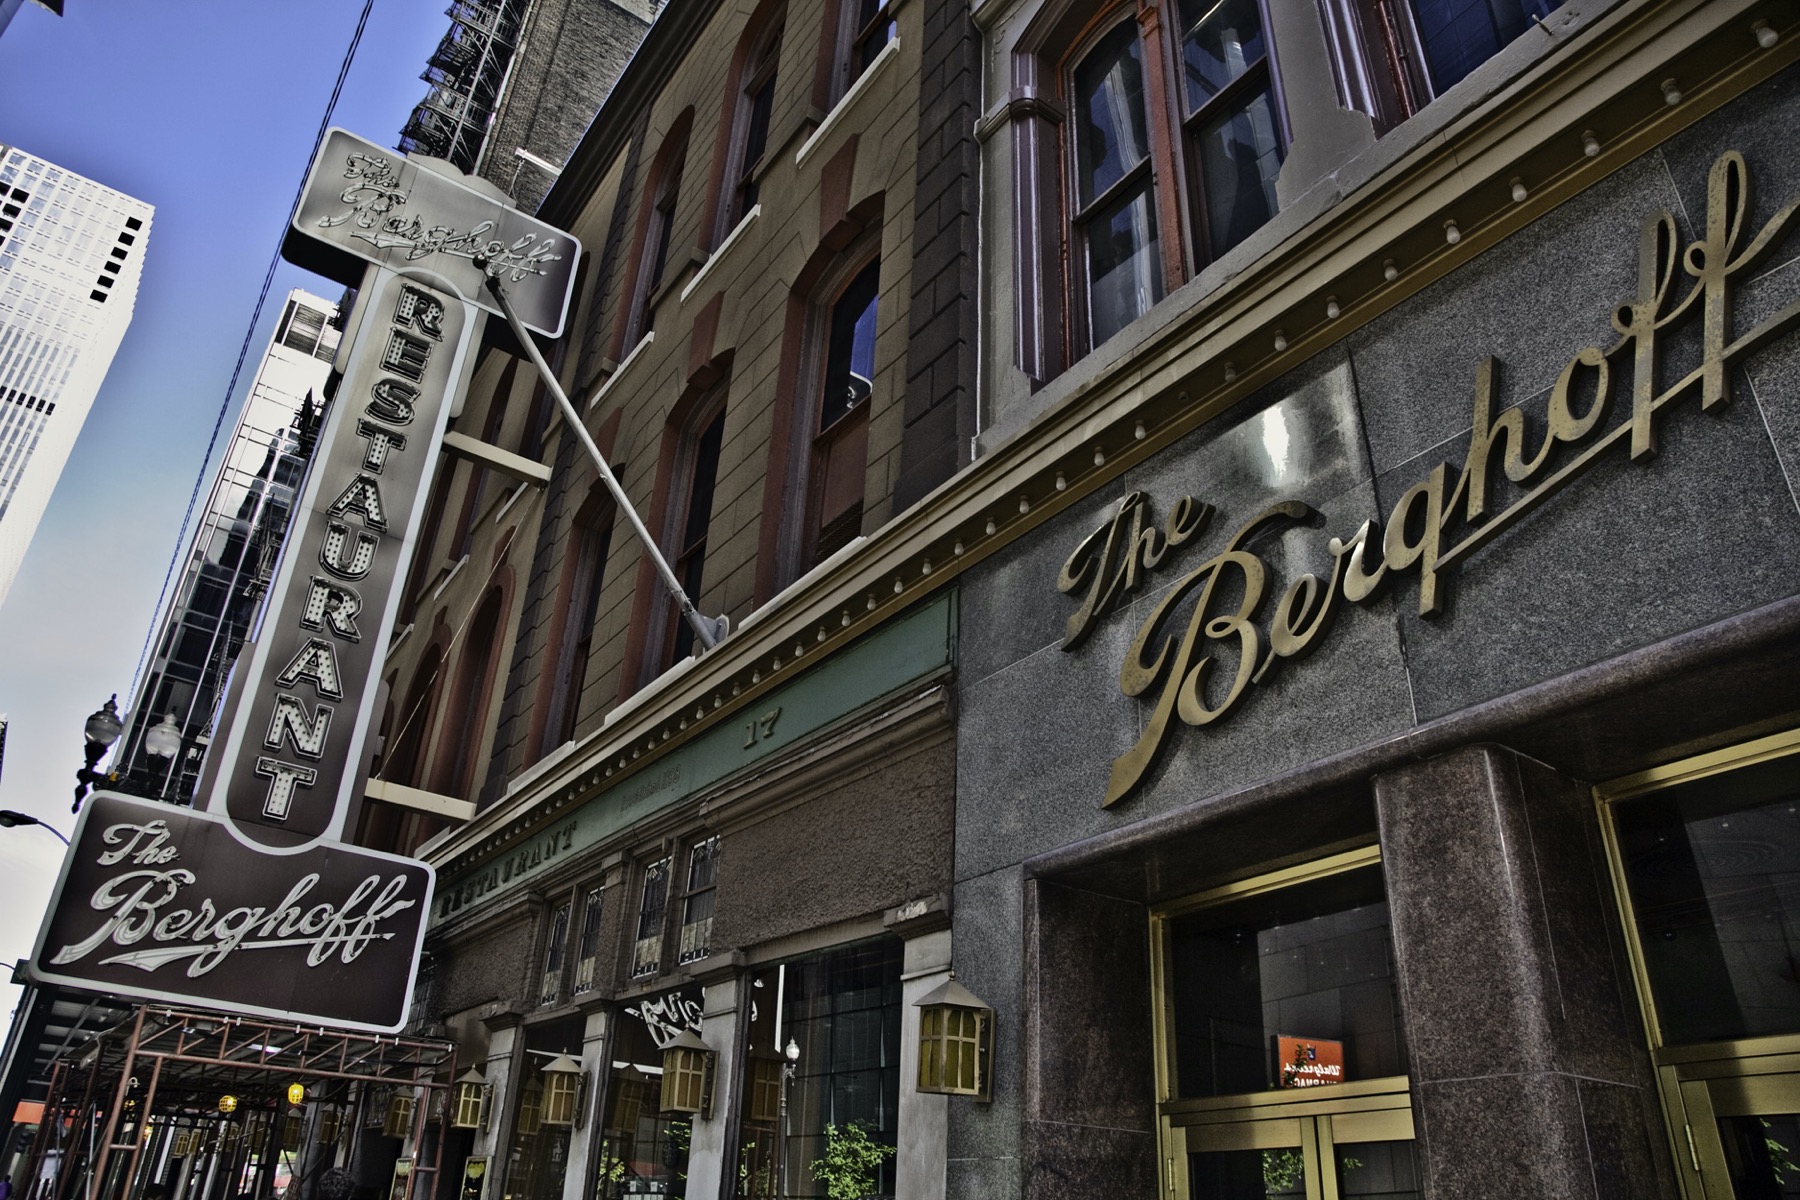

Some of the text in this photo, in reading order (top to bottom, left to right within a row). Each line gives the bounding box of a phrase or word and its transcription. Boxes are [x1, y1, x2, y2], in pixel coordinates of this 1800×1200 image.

[344, 152, 400, 188] The
[315, 183, 562, 283] Berghoff
[255, 283, 445, 821] RESTAURANT
[1056, 490, 1216, 652] The
[743, 706, 782, 750] 17
[96, 819, 181, 866] The
[439, 820, 577, 919] RESTAURANT
[49, 868, 416, 979] Berghoff
